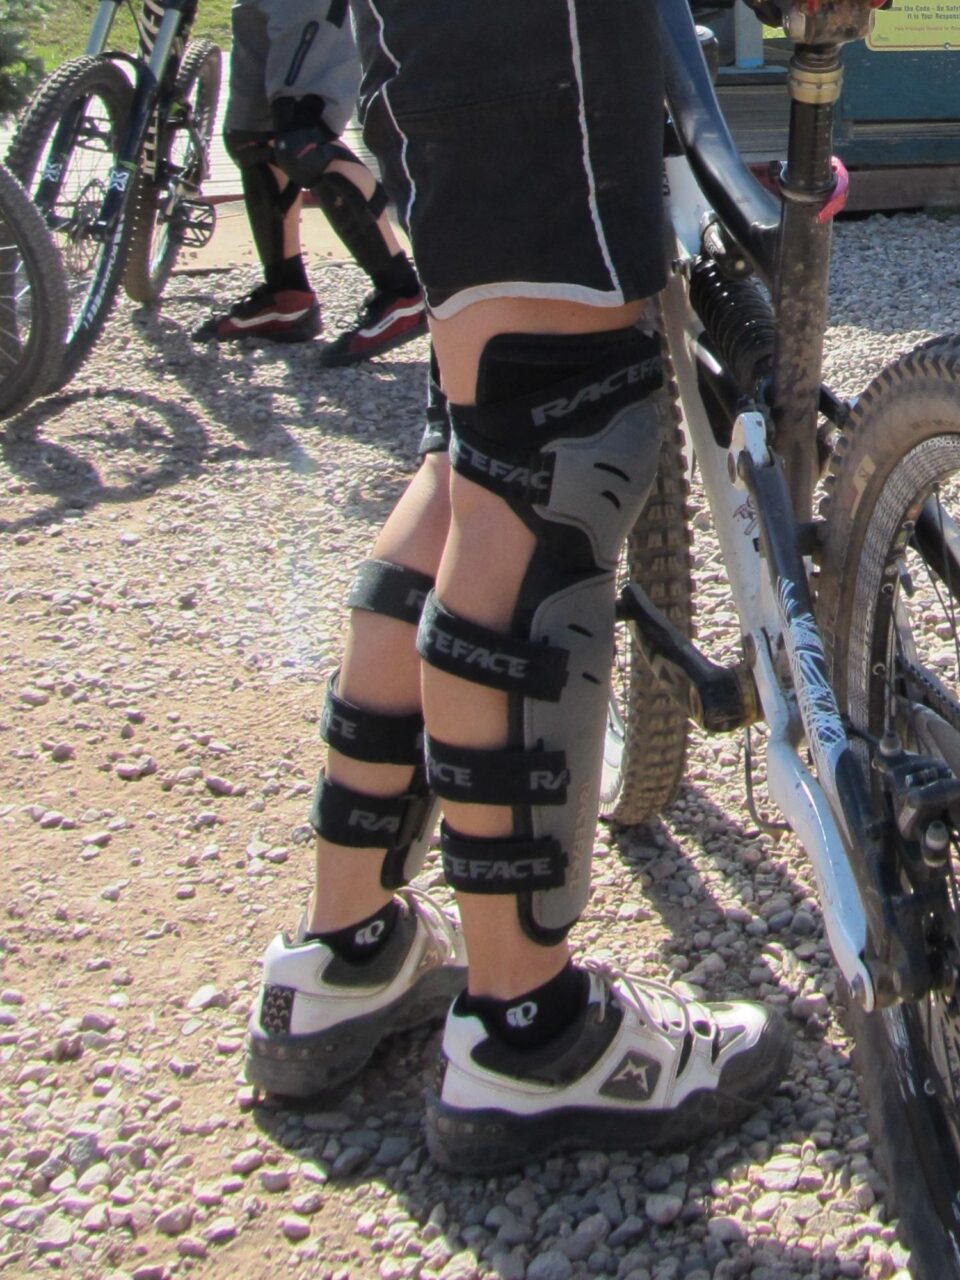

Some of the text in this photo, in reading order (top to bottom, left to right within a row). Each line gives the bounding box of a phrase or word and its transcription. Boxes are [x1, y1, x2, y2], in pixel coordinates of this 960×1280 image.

[531, 357, 663, 426] RACEF
[433, 627, 529, 679] EFACE
[449, 857, 551, 880] EFACE
